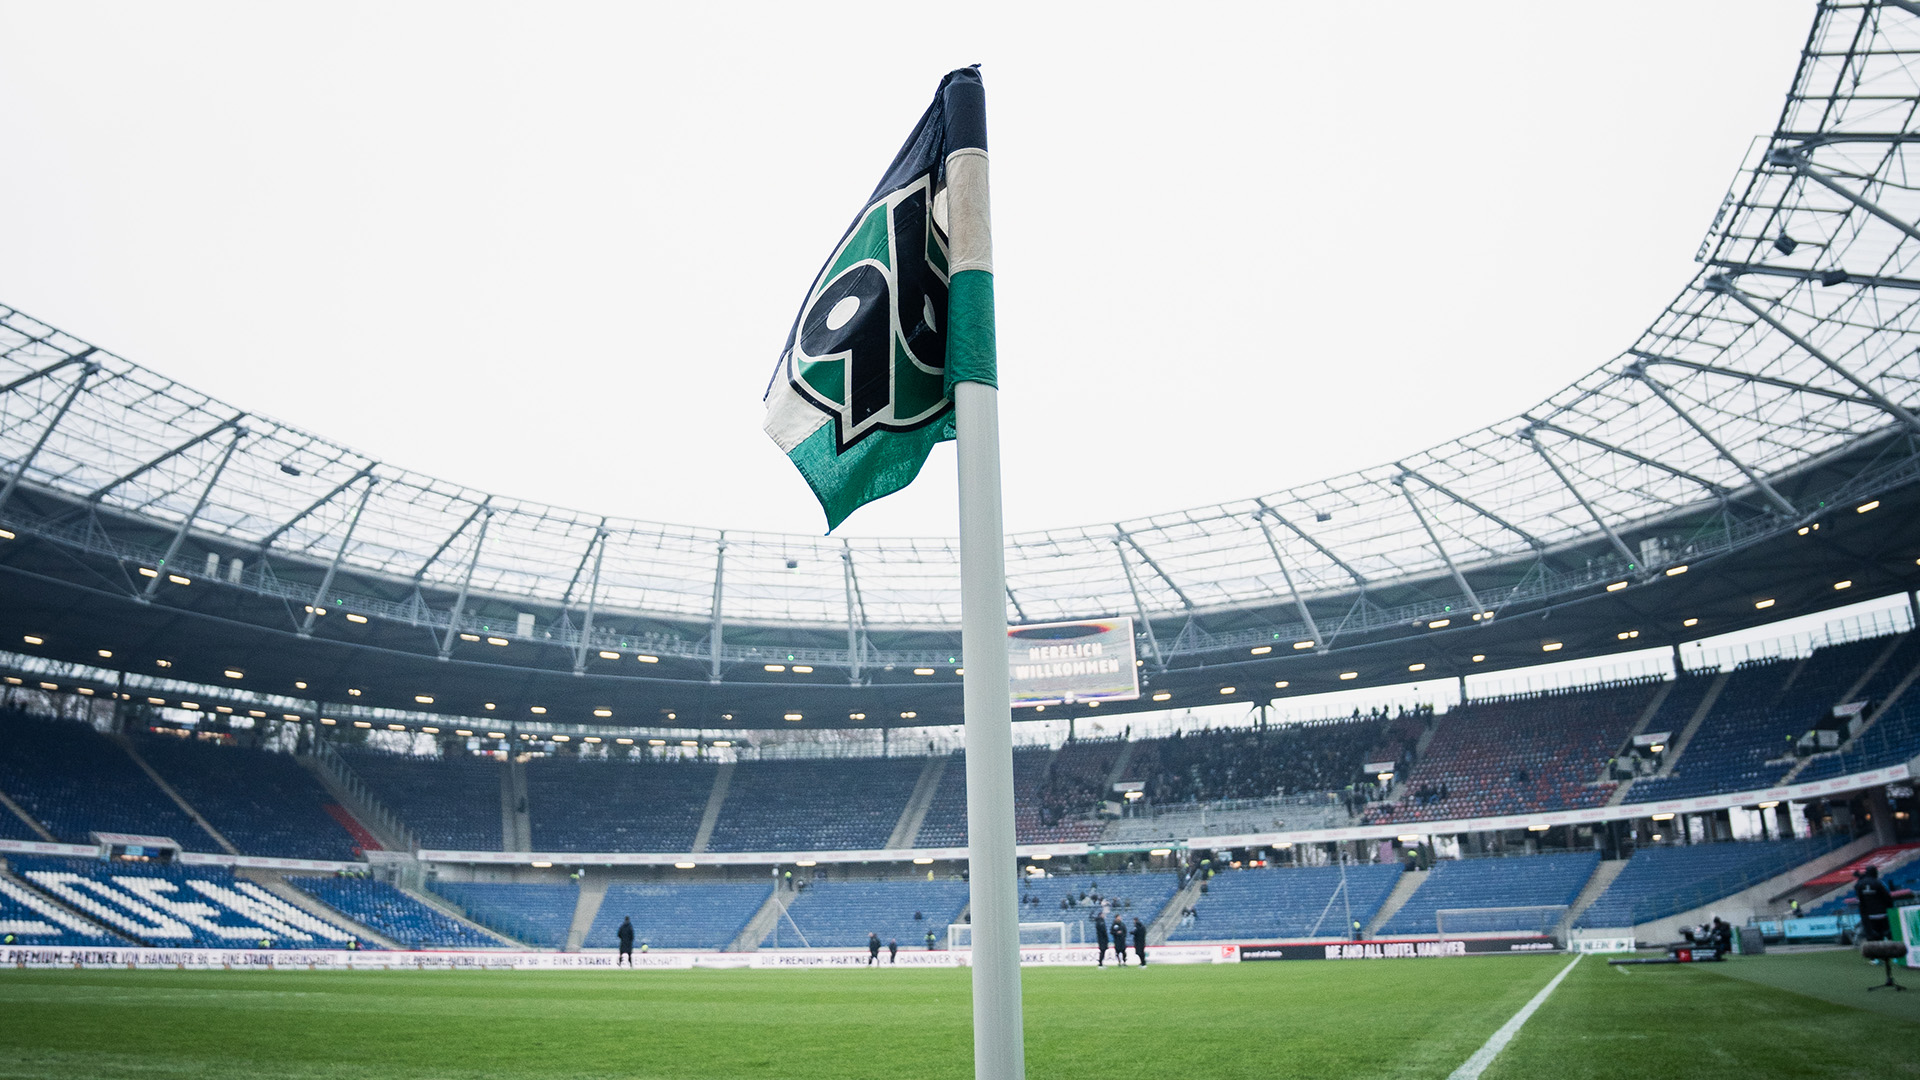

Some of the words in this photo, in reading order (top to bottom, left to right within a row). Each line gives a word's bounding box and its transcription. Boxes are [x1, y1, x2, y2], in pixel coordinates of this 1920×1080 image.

[800, 187, 949, 428] 96
[1029, 643, 1102, 660] HERZLICH
[1016, 659, 1119, 680] WILLKOMMEN
[9, 949, 118, 963] PREMIUM-PARTNER
[1325, 944, 1341, 959] ME
[1342, 944, 1363, 958] AND
[1364, 943, 1383, 957] ALL
[1384, 942, 1417, 957] HOTEL
[762, 955, 775, 965] DIE
